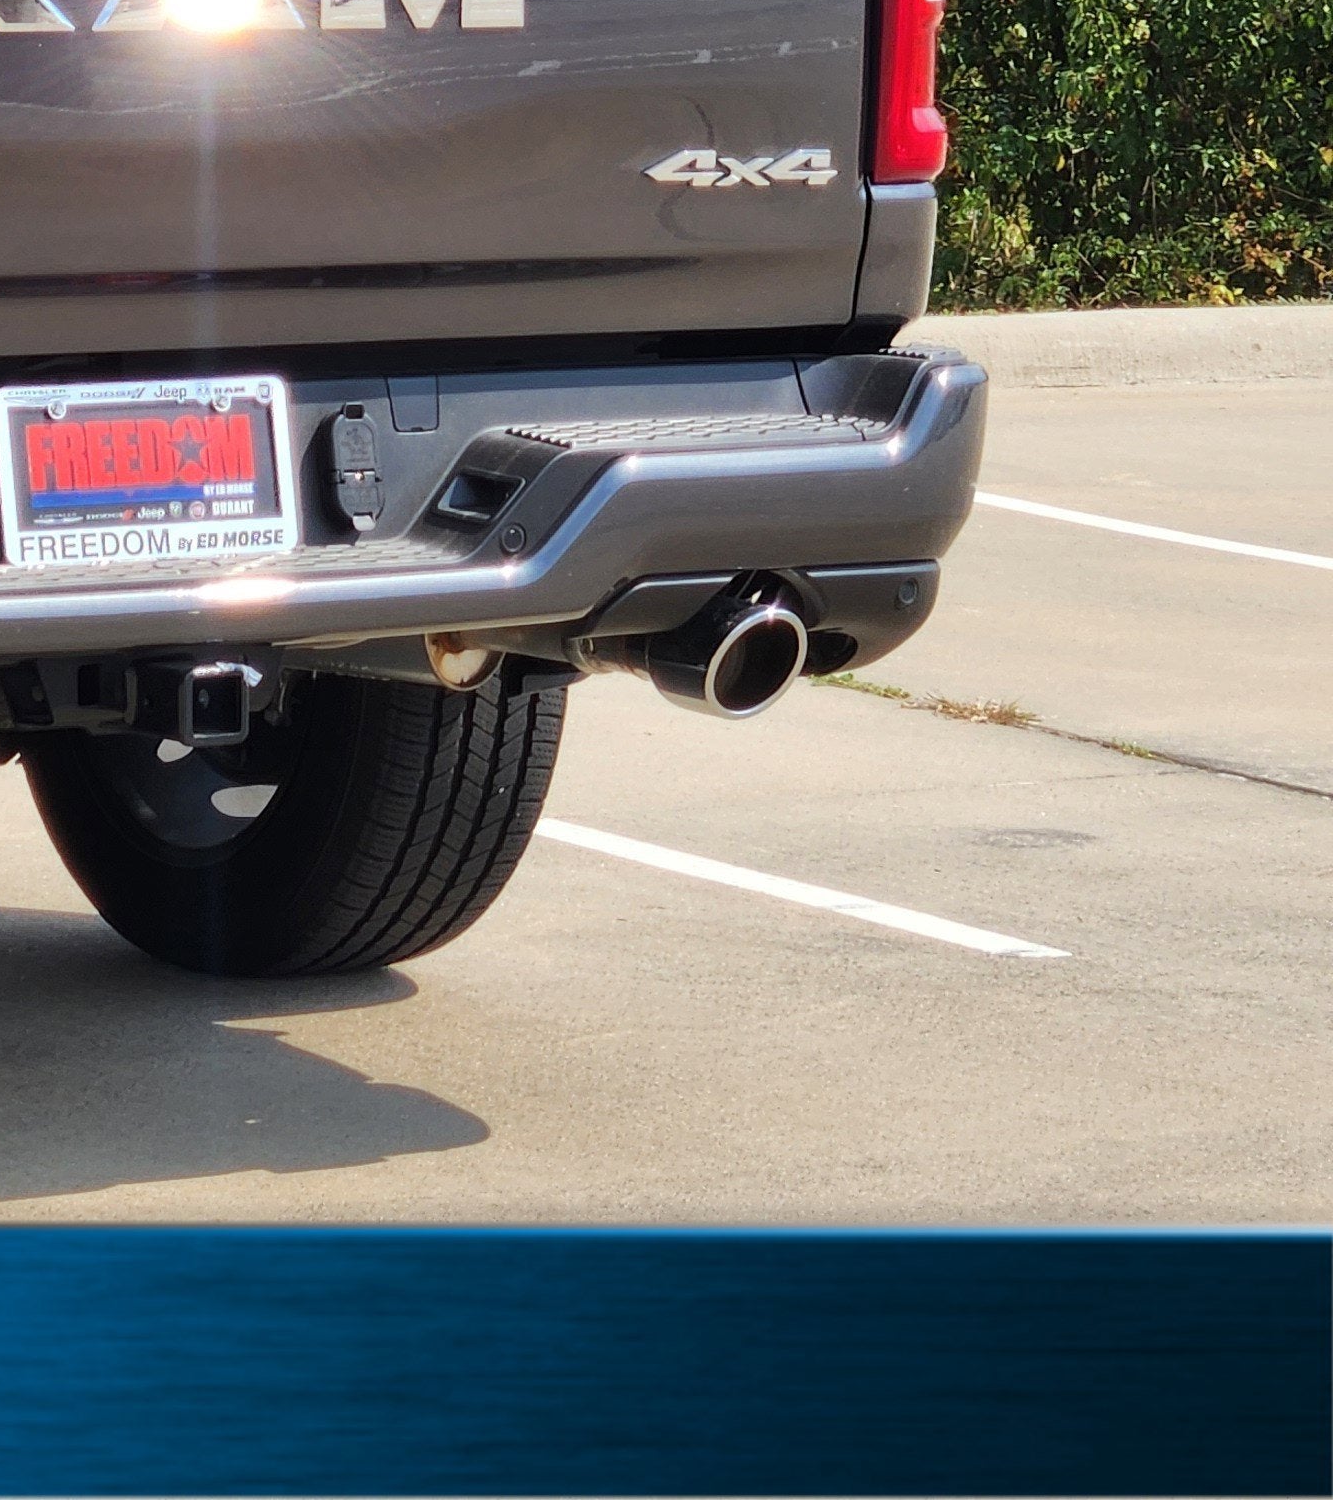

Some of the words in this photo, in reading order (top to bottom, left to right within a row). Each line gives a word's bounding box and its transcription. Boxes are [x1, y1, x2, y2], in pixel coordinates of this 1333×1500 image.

[153, 384, 188, 400] Jeep
[25, 413, 256, 491] FREEDOM
[137, 506, 166, 521] Jeep
[211, 499, 255, 517] DURANT
[19, 528, 172, 562] FREEDOM
[197, 533, 220, 550] ED
[222, 529, 284, 548] MORSE
